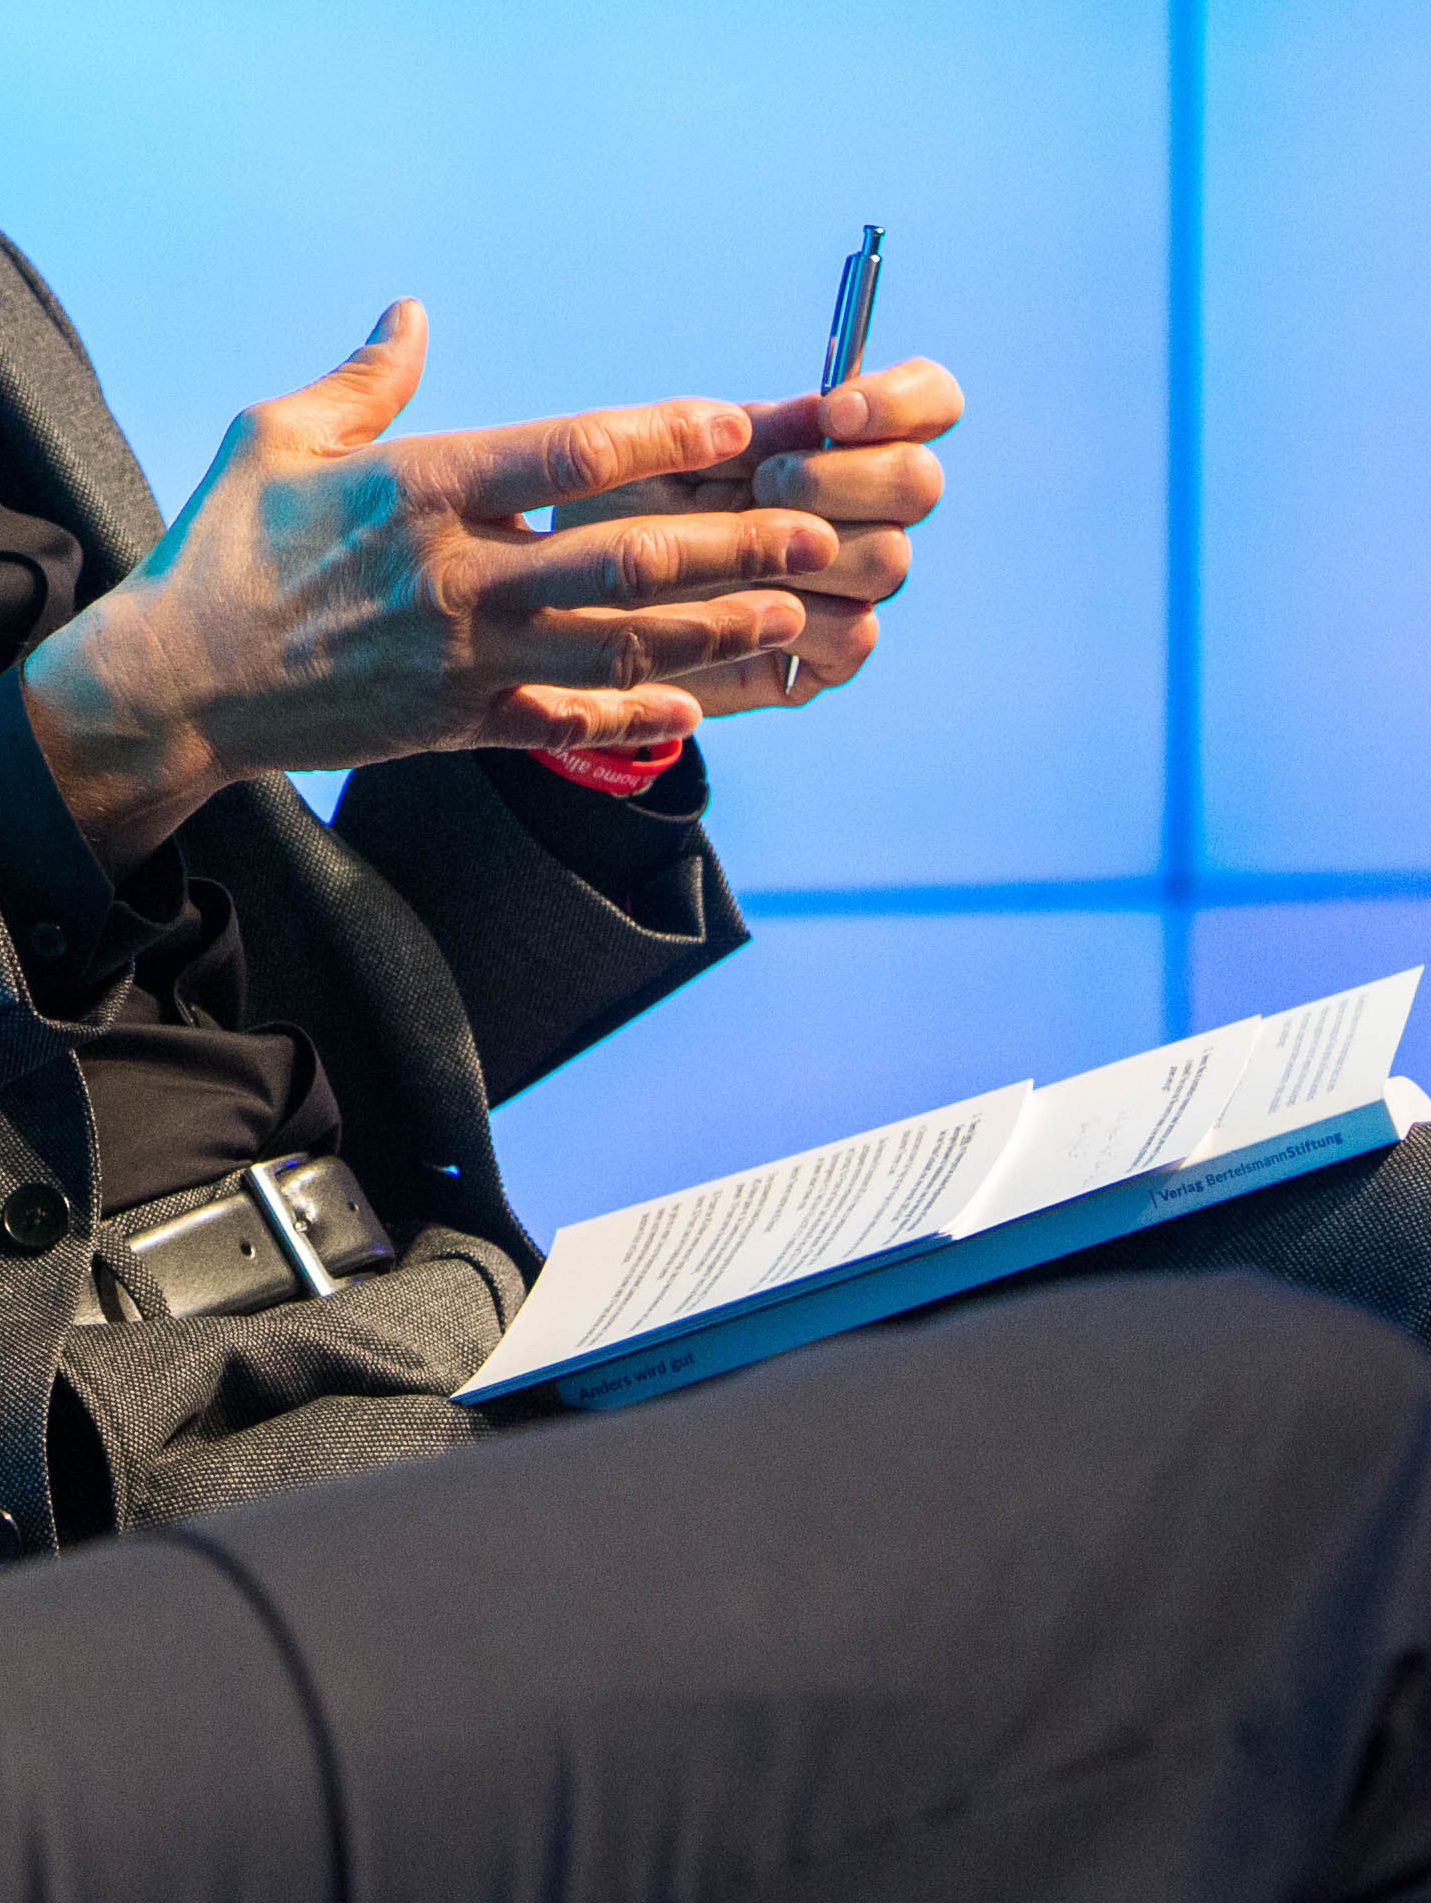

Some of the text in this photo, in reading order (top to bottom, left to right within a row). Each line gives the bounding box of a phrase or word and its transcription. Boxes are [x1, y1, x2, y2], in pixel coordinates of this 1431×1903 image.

[593, 766, 642, 788] home
[1157, 1132, 1343, 1202] Verlag BertelsmannStiftung
[579, 1352, 696, 1401] Anders wird gut
